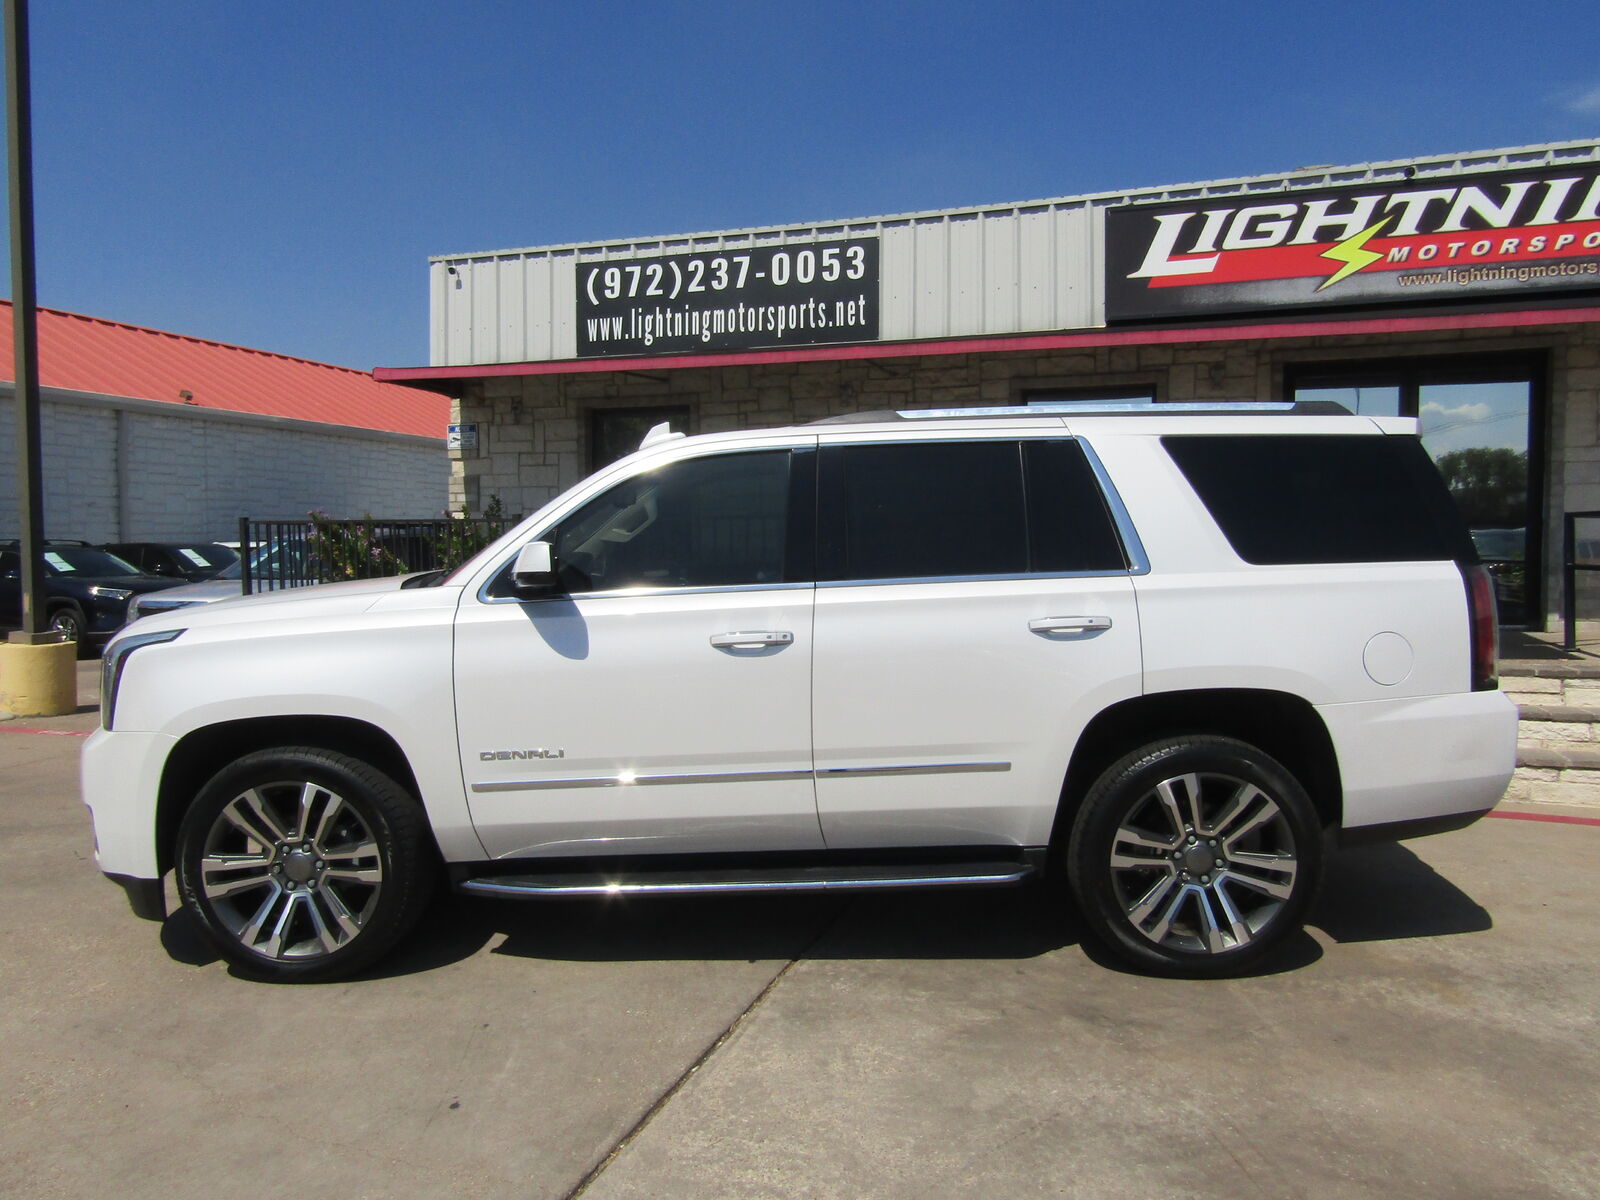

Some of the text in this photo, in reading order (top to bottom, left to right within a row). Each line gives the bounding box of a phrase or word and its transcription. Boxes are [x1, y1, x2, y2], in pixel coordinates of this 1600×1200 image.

[1386, 231, 1600, 263] MOTORSPO
[586, 245, 866, 306] (972)237-0053
[586, 294, 866, 347] www.lightningmotorsports.net
[480, 749, 565, 761] DENALI
